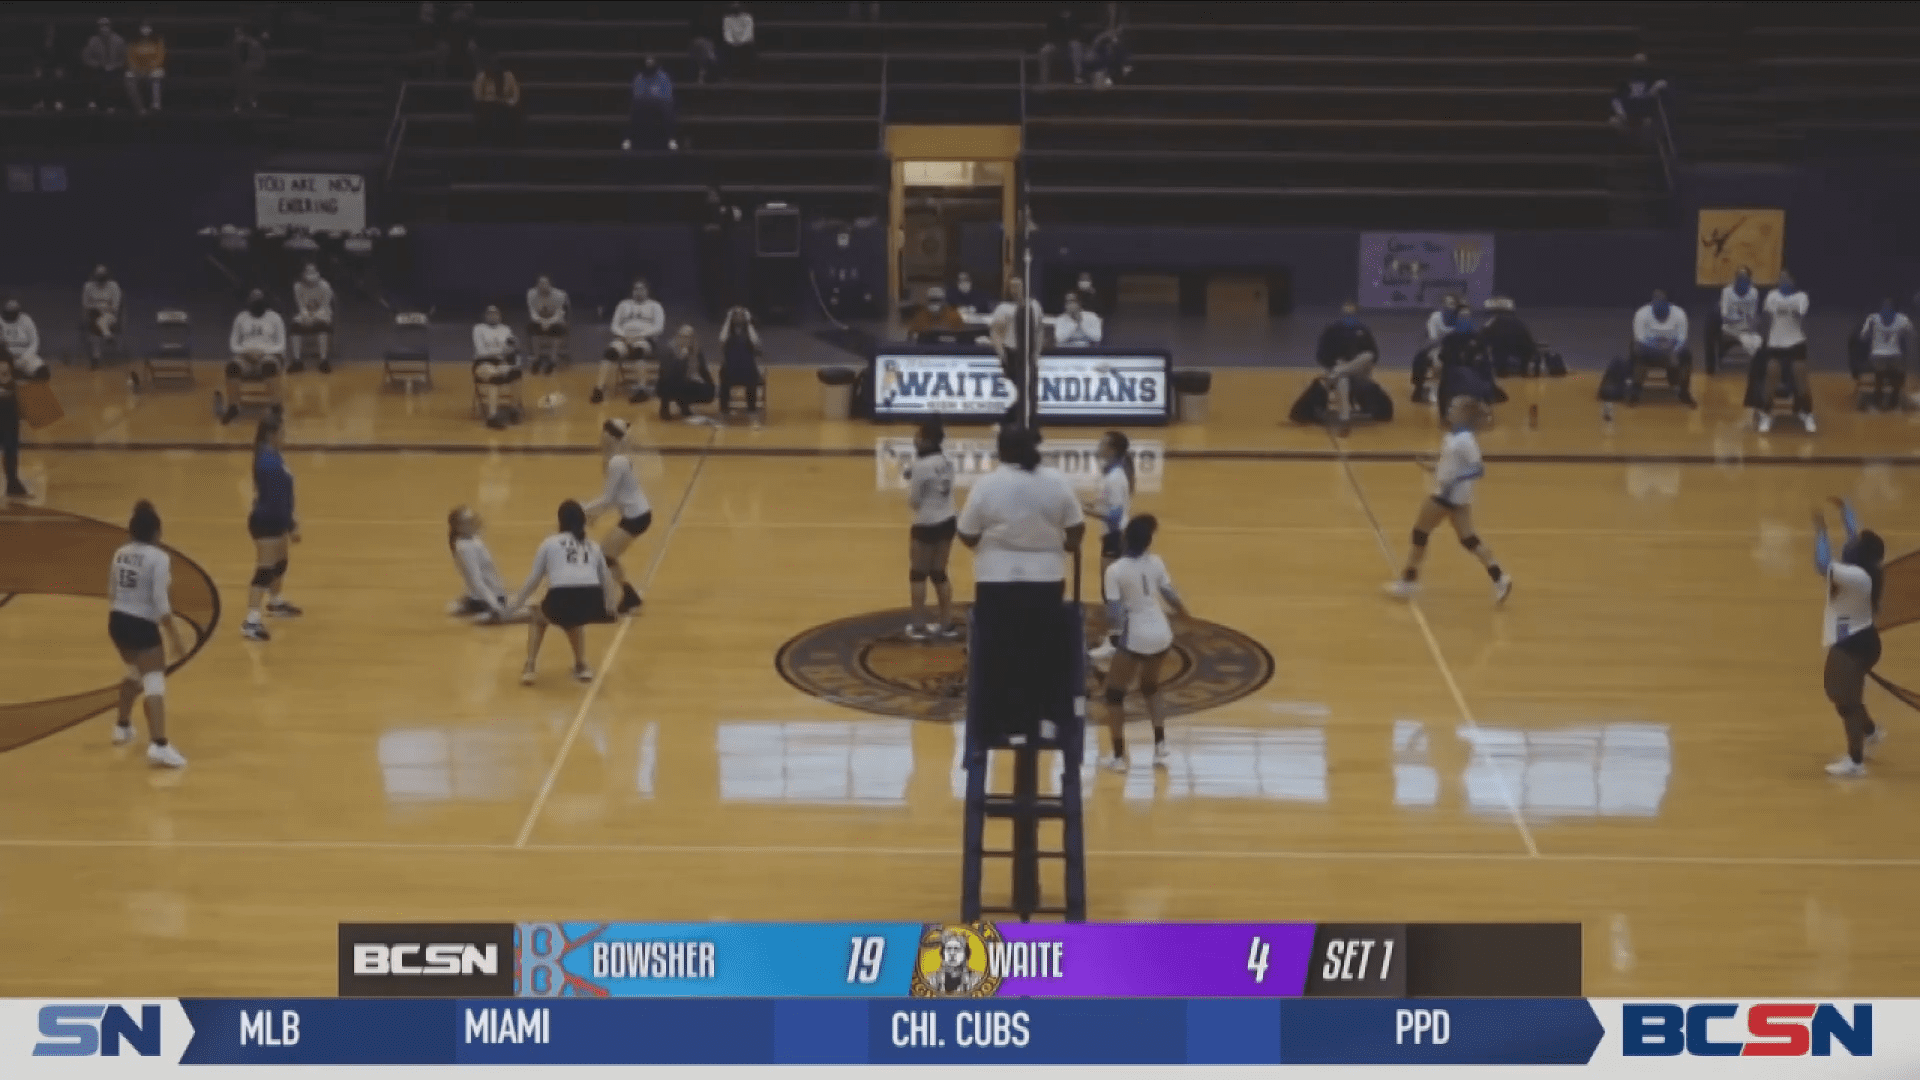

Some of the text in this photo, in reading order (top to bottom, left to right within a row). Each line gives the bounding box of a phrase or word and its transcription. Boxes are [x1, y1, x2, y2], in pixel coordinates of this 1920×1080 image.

[258, 175, 285, 191] YOU
[328, 176, 361, 192] NOW
[895, 371, 1157, 402] WAITE NDIANS
